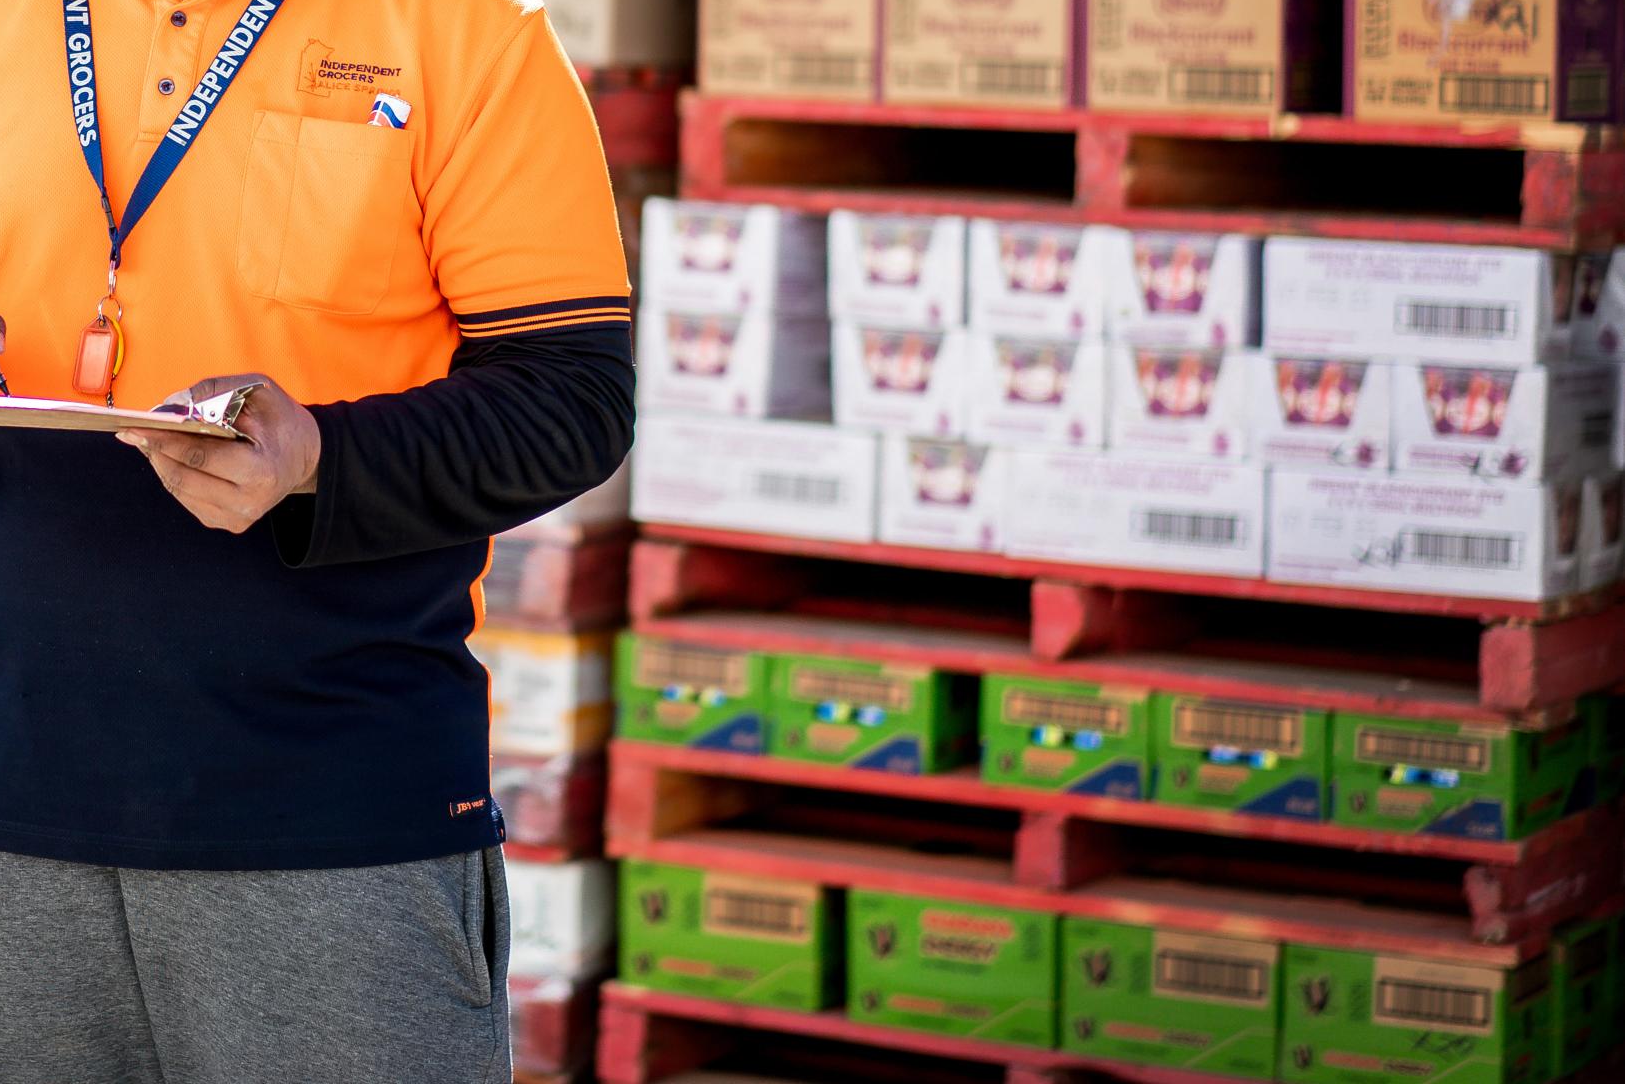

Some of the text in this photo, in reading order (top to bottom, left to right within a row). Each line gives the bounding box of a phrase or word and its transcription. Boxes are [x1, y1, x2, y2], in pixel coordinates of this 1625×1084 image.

[320, 59, 402, 77] INDEPENDENT
[318, 69, 375, 84] GROCERS
[67, 32, 96, 147] GROCERS
[317, 81, 351, 91] ALICE
